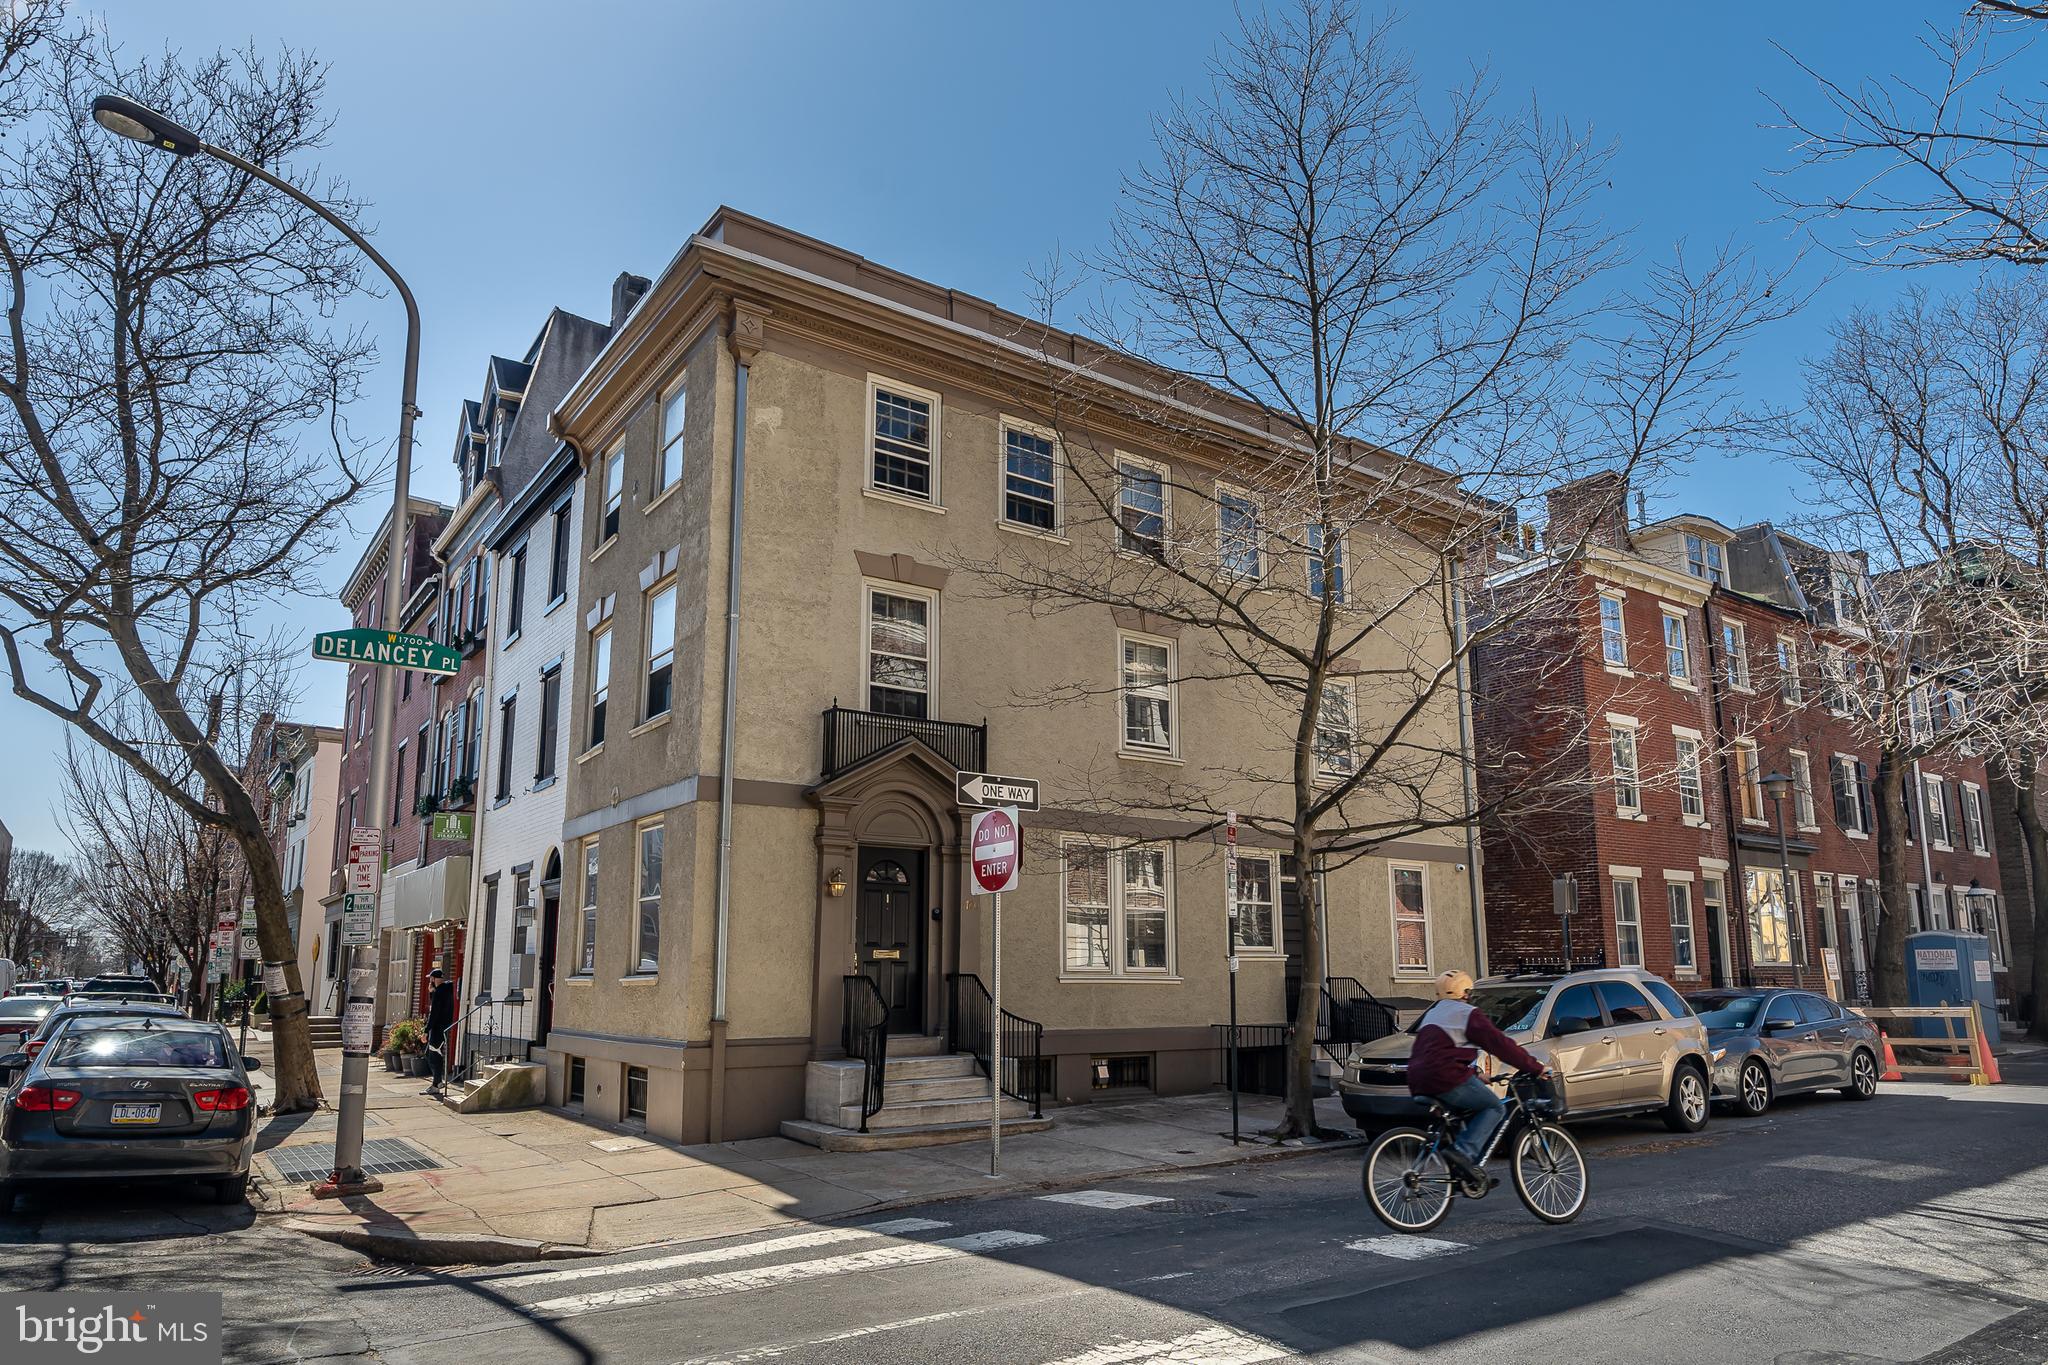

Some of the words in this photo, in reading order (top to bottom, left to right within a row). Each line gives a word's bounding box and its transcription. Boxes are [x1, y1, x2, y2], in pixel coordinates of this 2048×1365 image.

[388, 634, 397, 643] W
[398, 636, 423, 646] 1700
[320, 635, 434, 666] DELANCEY
[443, 657, 458, 670] PL
[982, 784, 1005, 798] ONE
[1007, 788, 1031, 801] WAY
[978, 829, 990, 842] DO
[994, 824, 1011, 839] NOT
[351, 849, 359, 860] NO
[359, 850, 379, 858] PARKING
[357, 865, 371, 873] ANY
[981, 861, 1008, 877] ENTER
[356, 873, 370, 882] TIME
[346, 896, 353, 910] 2
[354, 903, 374, 911] PARKING
